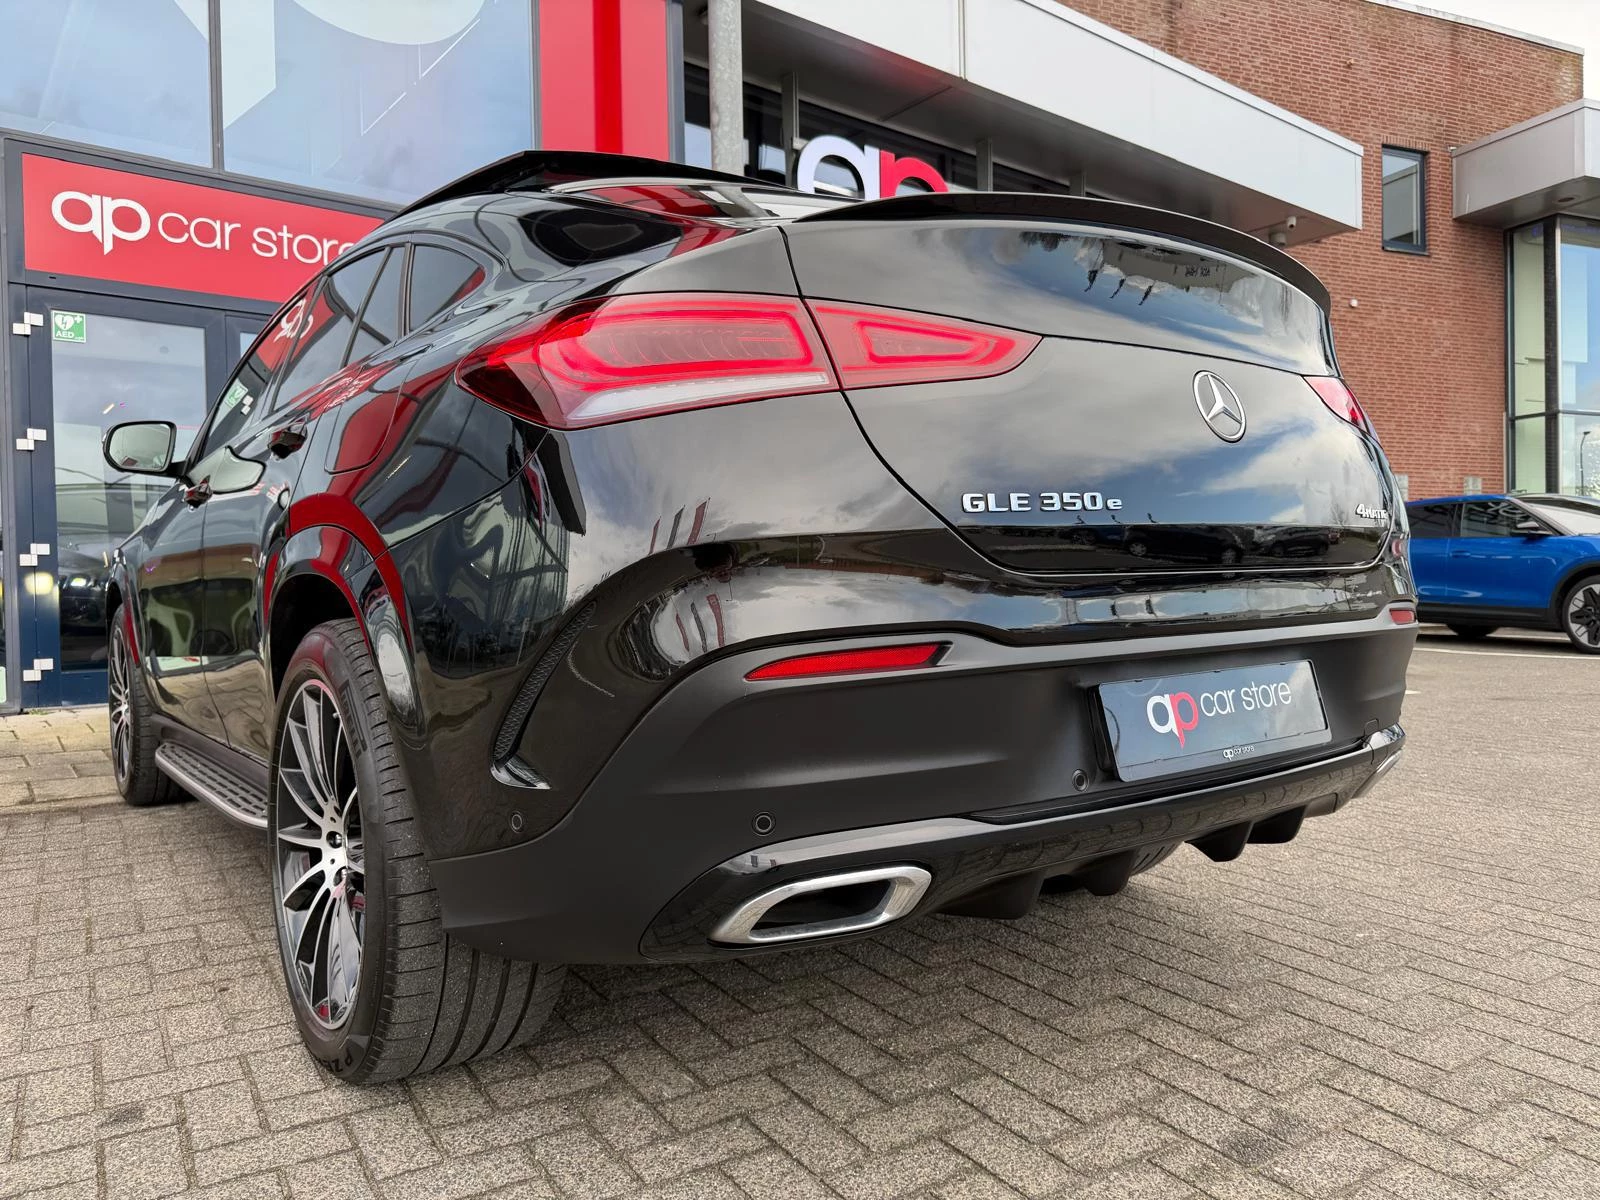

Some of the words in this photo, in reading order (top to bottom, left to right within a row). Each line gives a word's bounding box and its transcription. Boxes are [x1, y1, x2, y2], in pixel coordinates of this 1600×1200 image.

[51, 190, 151, 256] ap
[157, 212, 241, 250] car
[55, 330, 75, 339] AED
[962, 492, 1032, 513] GLE
[1146, 691, 1199, 749] ap
[1200, 688, 1236, 717] car
[1240, 681, 1292, 711] store
